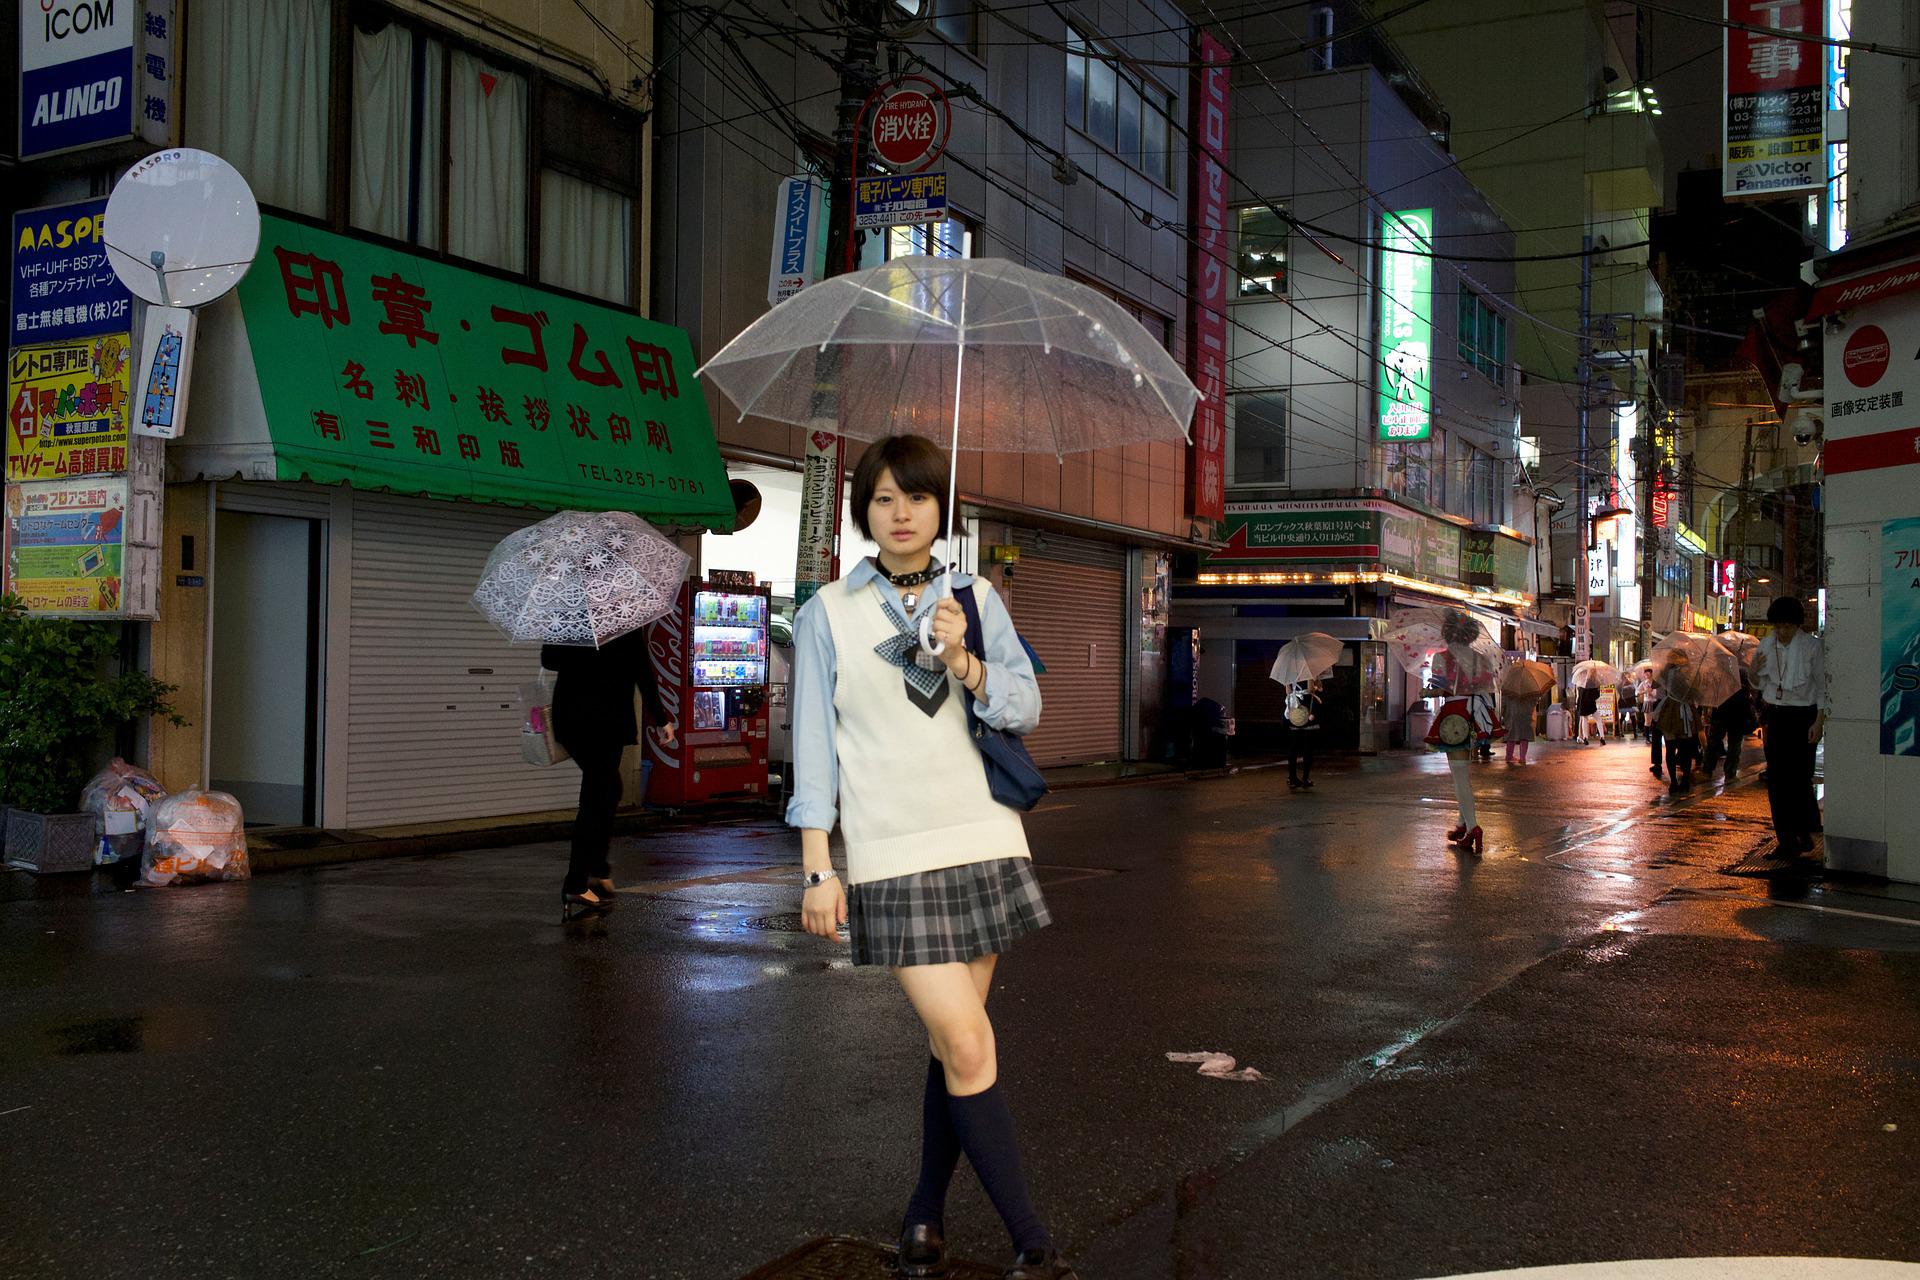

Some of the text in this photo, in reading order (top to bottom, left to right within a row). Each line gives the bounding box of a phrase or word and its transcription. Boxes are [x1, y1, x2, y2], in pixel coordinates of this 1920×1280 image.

[32, 76, 123, 127] ALINCO
[885, 100, 927, 110] FIRE HYDRANT
[879, 112, 932, 143] 消火栓
[1736, 174, 1812, 191] Panasonic
[1756, 161, 1812, 177] Victor
[859, 175, 945, 204] 電子パーツ専門店
[784, 181, 809, 273] コスメイトプラス
[900, 211, 923, 222] この先
[29, 272, 116, 298] 各種アンテナパーツ
[273, 245, 680, 401] 印章・ゴム印
[12, 349, 89, 379] レトロ専門店
[20, 391, 35, 436] 入口
[342, 361, 672, 455] 名刺・挨拶状印刷
[1831, 391, 1903, 418] 画像安定装置
[39, 433, 127, 448] http://www.superpotato.com
[9, 447, 126, 478] TVゲーム高額買取
[577, 463, 705, 495] TEL3257-0781
[1254, 521, 1371, 532] メロンブックス秋葉原1号店へは
